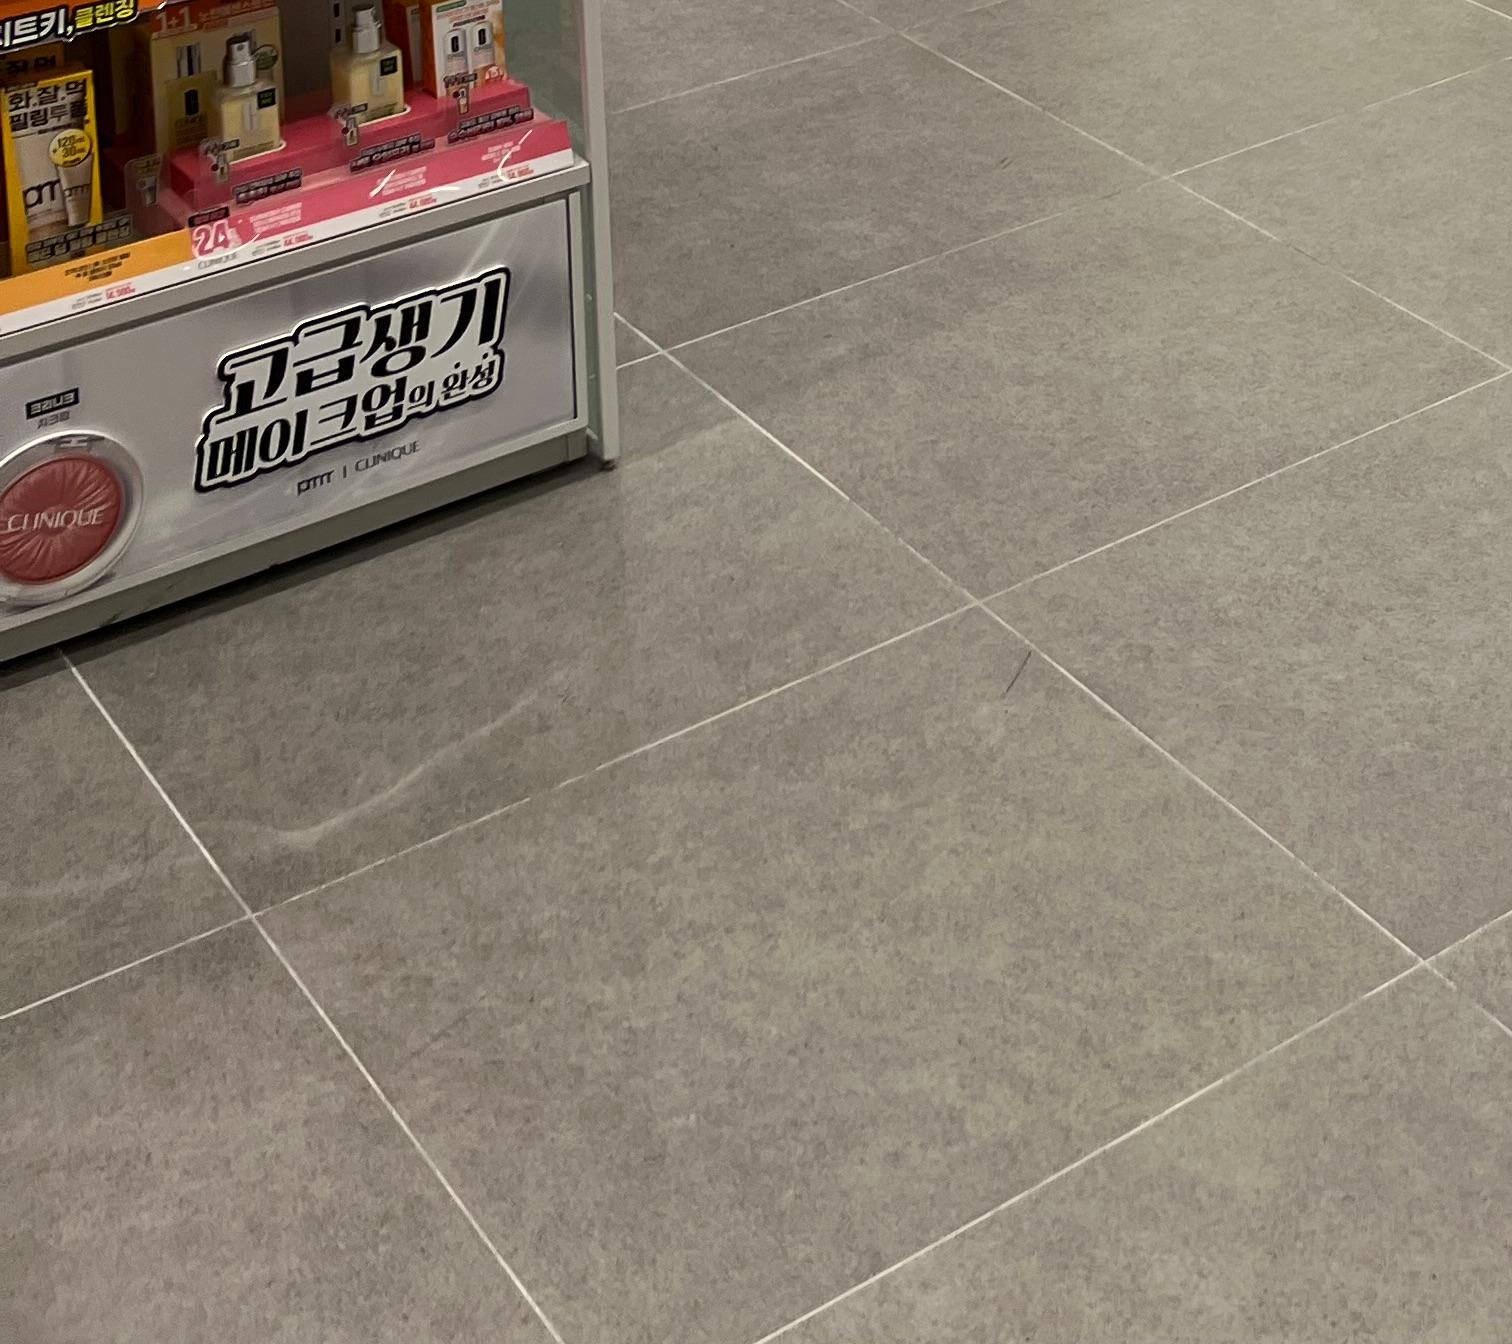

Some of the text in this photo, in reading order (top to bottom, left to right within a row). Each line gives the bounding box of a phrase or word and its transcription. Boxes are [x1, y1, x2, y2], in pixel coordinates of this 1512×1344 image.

[226, 276, 504, 420] 고급생기
[443, 361, 498, 401] 완성
[355, 439, 421, 474] CLINIQUE
[7, 509, 104, 530] CLINIQUE
